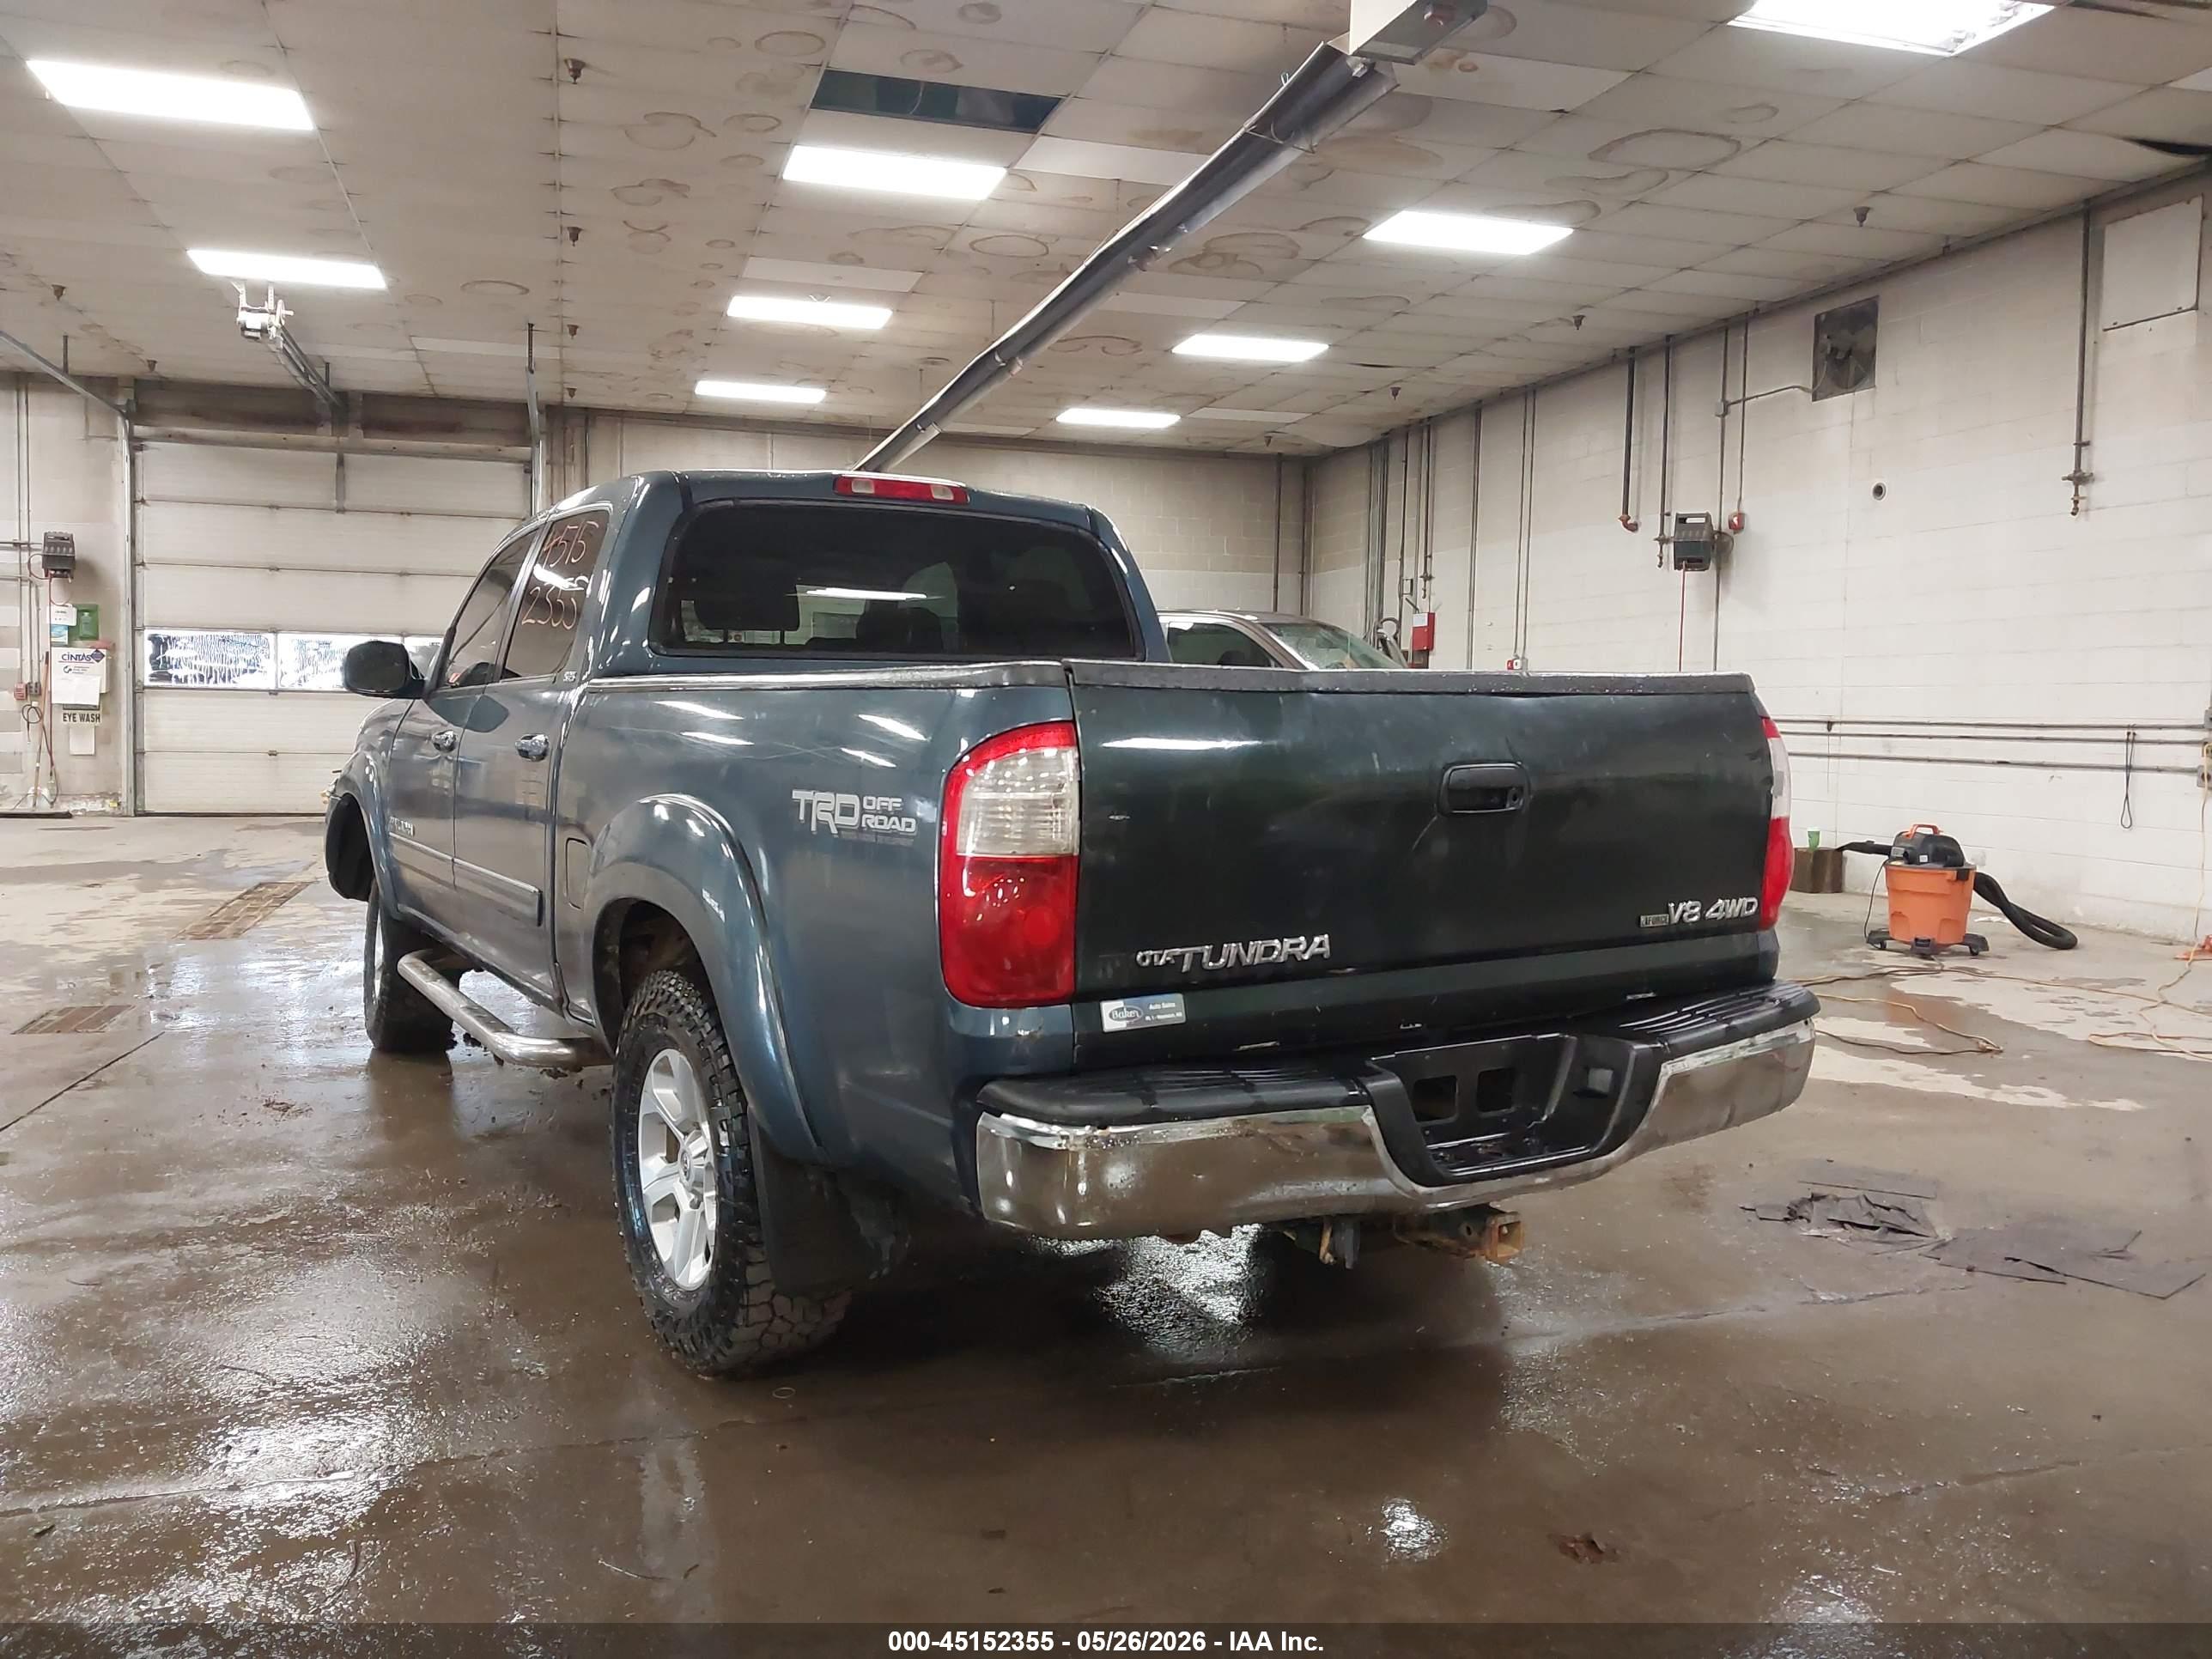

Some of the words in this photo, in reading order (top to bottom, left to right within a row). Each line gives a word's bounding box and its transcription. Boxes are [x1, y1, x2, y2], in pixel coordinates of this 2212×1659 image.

[63, 713, 77, 722] EYE
[79, 713, 100, 723] WASH
[792, 789, 860, 835] TRD
[862, 795, 902, 811] OFF
[861, 813, 917, 833] ROAD
[1668, 900, 1702, 925] V8
[1705, 896, 1759, 921] 4WD
[1170, 933, 1330, 973] TUNDRA
